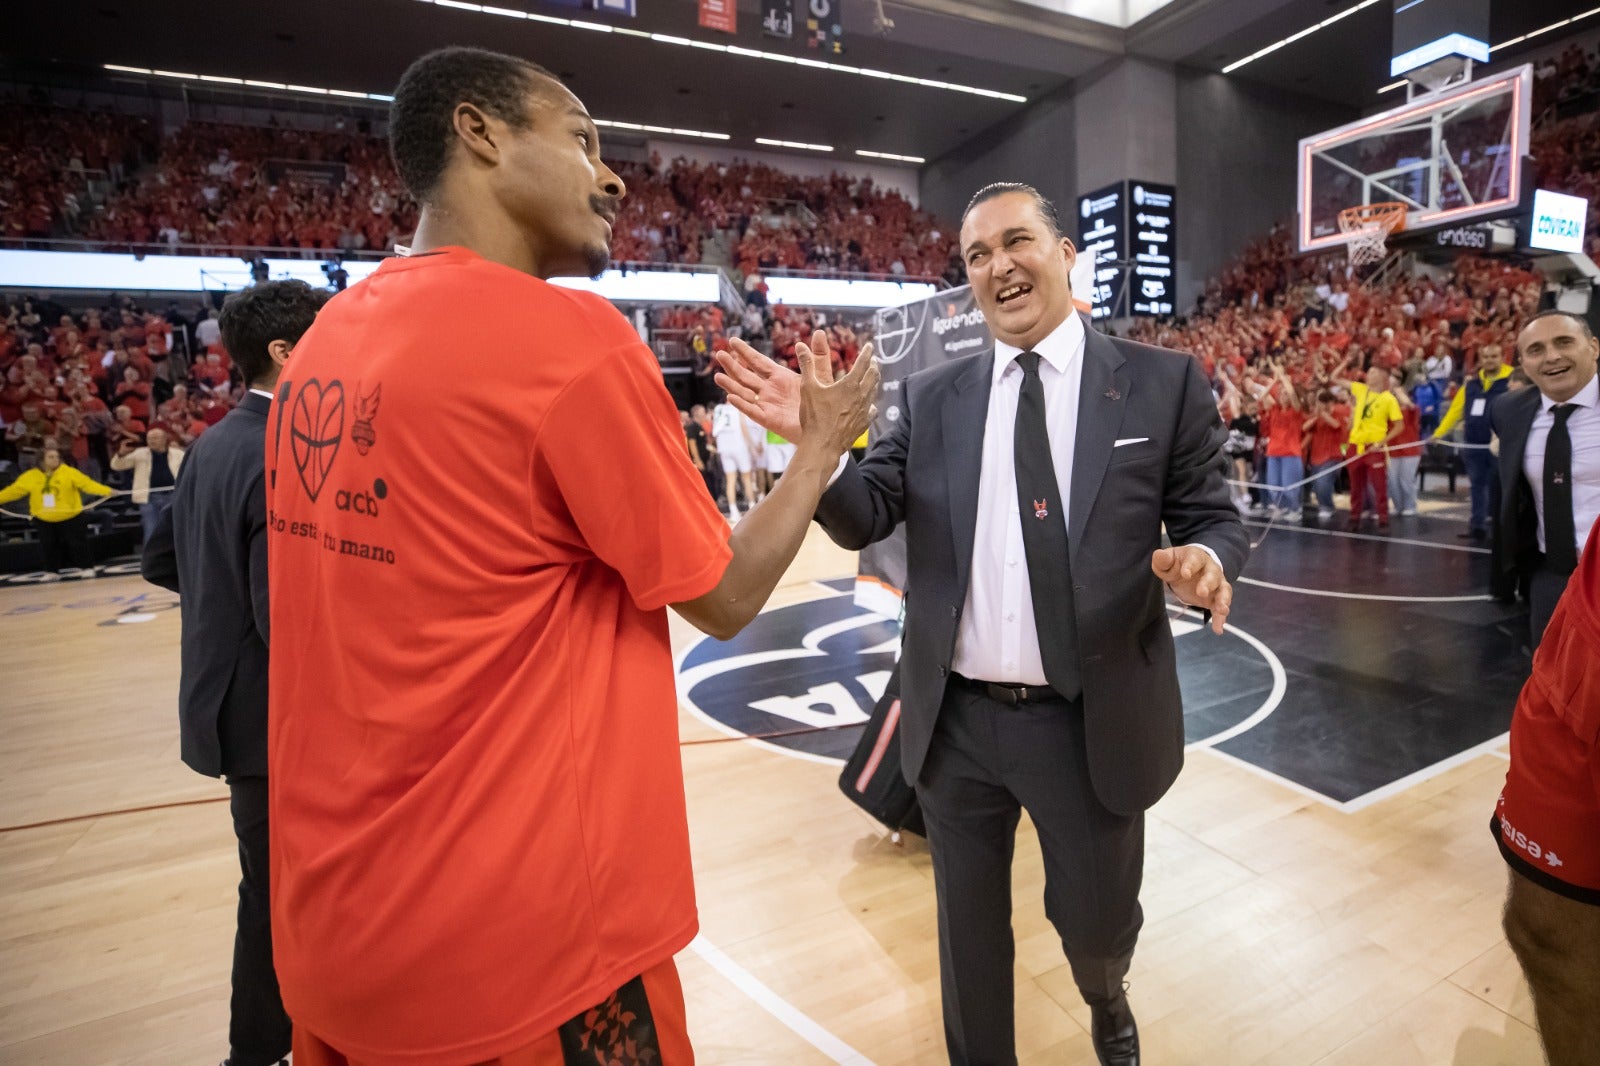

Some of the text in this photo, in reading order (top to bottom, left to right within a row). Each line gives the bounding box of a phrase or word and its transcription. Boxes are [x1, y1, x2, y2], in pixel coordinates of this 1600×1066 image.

[1437, 226, 1486, 249] endesa
[335, 489, 379, 518] acb
[339, 539, 395, 565] mano
